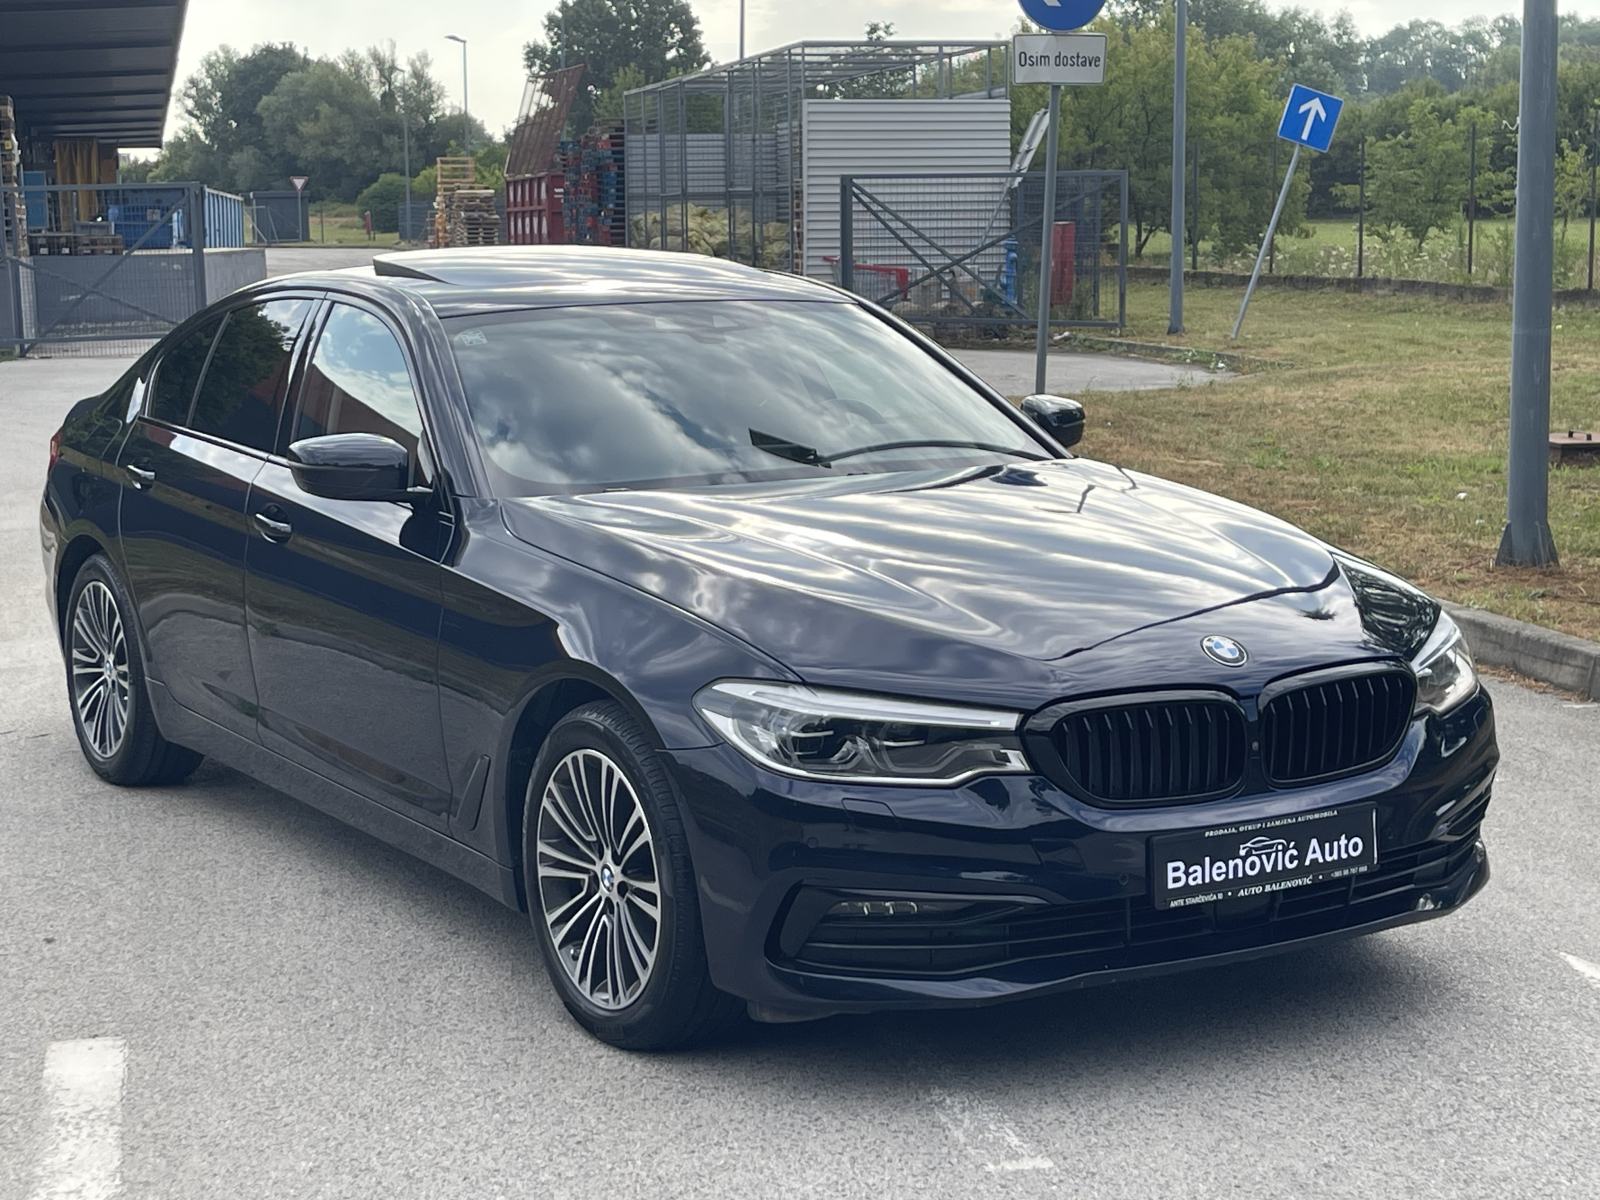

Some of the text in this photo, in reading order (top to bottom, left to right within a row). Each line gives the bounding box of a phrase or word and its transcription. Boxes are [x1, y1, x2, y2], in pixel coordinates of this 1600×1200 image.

[1018, 51, 1101, 68] Osim dostave
[1166, 833, 1363, 889] Balenović Auto
[1237, 874, 1313, 897] AUTO BALENOVIĆ
